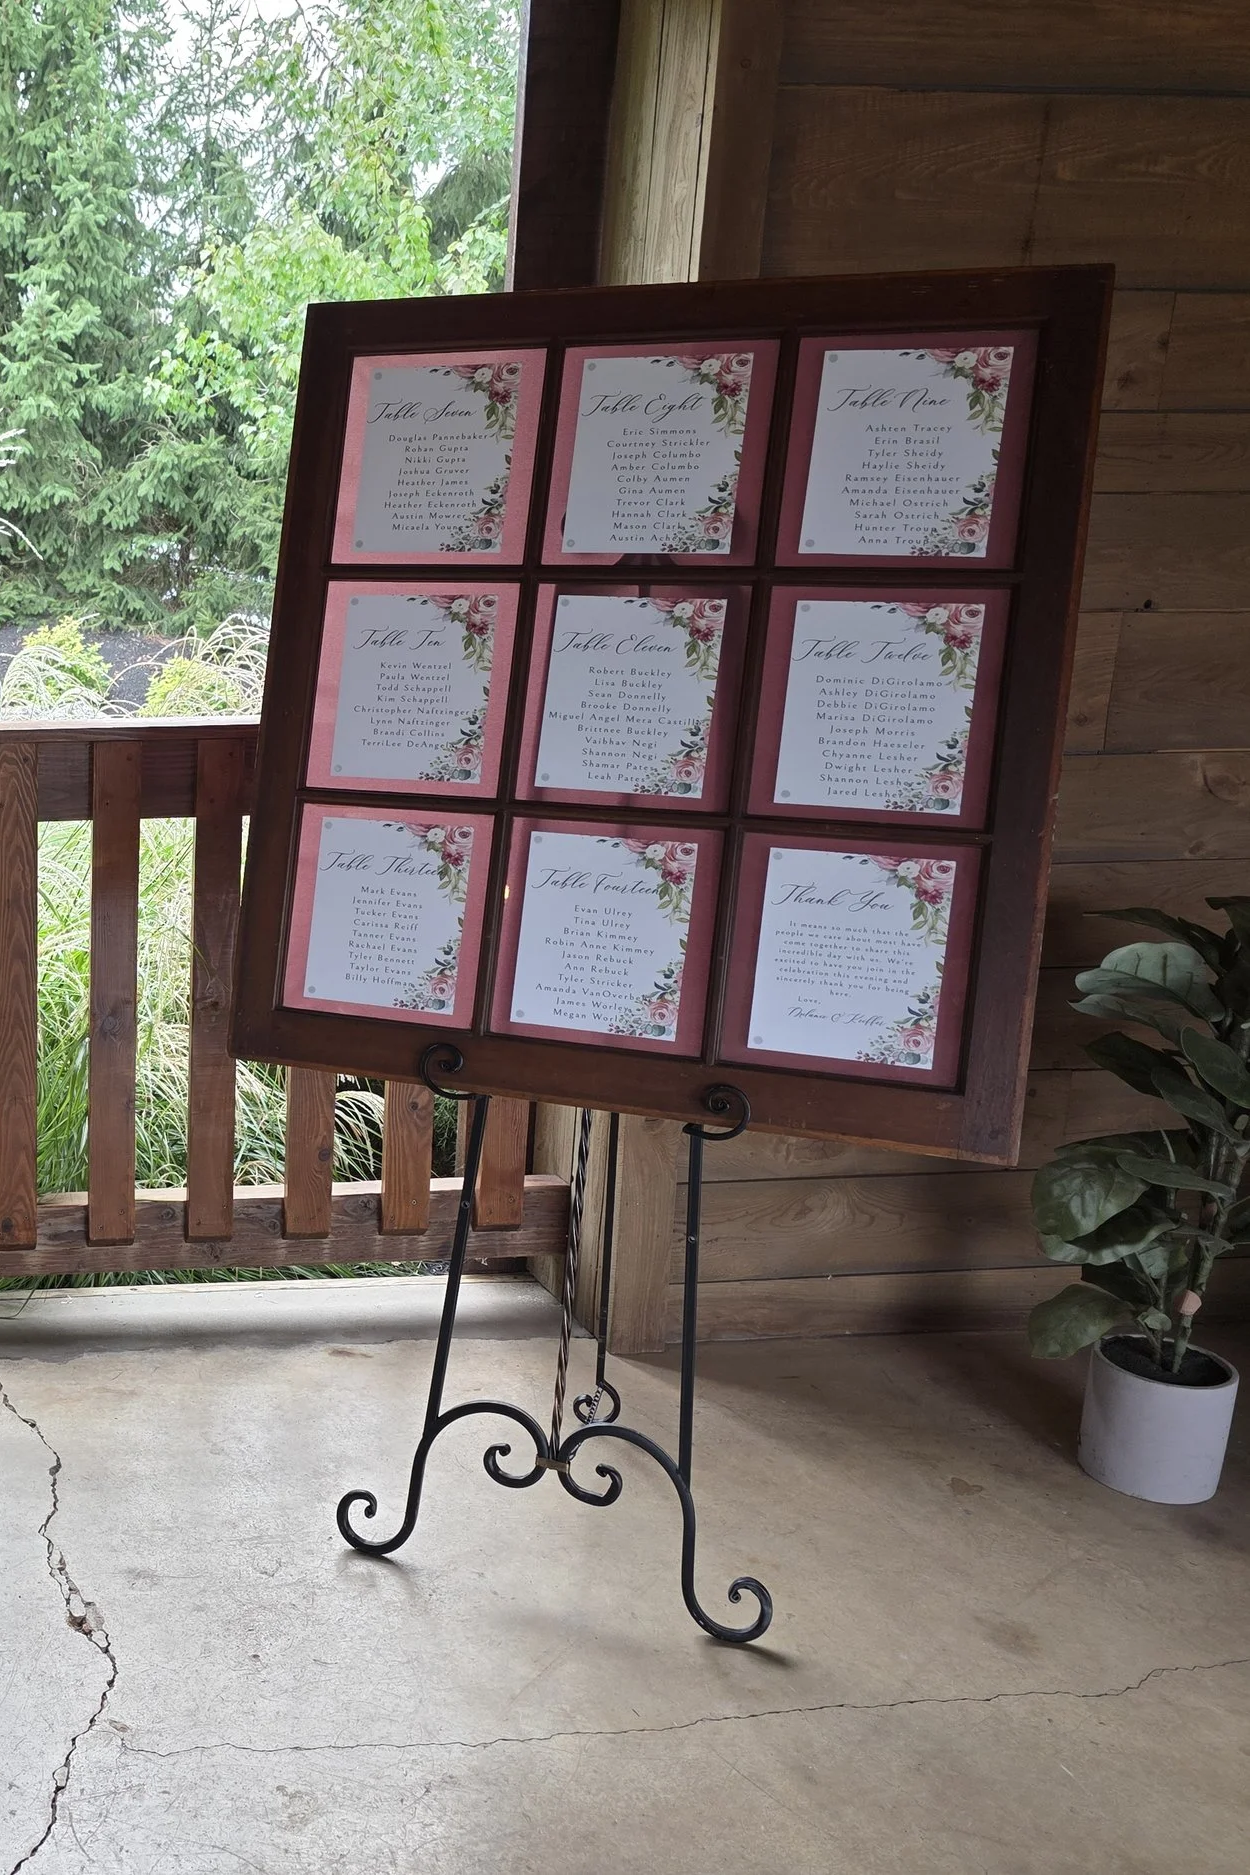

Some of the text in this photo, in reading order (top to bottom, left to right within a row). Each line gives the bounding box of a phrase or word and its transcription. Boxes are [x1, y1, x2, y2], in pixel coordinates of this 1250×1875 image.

[826, 384, 952, 414] Table Nine
[366, 398, 477, 424] Table Seven
[581, 390, 704, 424] Table Eight
[622, 427, 697, 436] Eric Simmons
[865, 424, 953, 433] Ashten Tracey
[874, 436, 940, 445] Erin Brasil
[404, 456, 466, 465] Nikki Gupta
[612, 451, 701, 461] Joseph Columbo
[398, 468, 430, 476] Joshua
[611, 462, 700, 471] Amber Columbo
[845, 474, 962, 483] Ramsey Eisenhauer
[388, 488, 475, 499] Joseph Eckenroth
[841, 486, 962, 495] Amanda Eisenhauer
[616, 498, 686, 506] Trevor Clark
[352, 625, 447, 651] Table Ten
[553, 628, 675, 655] Table Eleven
[792, 635, 934, 664] Table Twelve
[412, 662, 452, 670] Wentzel
[588, 667, 672, 679] Robert Buckley
[594, 679, 663, 690] Lisa Buckley
[815, 675, 943, 687] Dominic DiGirolamo
[376, 683, 451, 694] Todd Schappell
[819, 688, 936, 700] Ashley DiGirolamo
[373, 728, 445, 737] Brandi Collins
[830, 725, 916, 737] Joseph Morris
[585, 736, 658, 750] Vaibhav Negi
[825, 762, 913, 774] Dwight Lesher
[319, 849, 375, 872] Table
[531, 866, 660, 895] Table Fourteen
[352, 896, 423, 910] Jennifer Evans
[770, 883, 895, 913] Thank You
[354, 907, 419, 920] Tucker Evans
[574, 905, 633, 918] Evan Ulrey
[800, 922, 828, 930] means
[563, 927, 639, 943] Brian Kimmey
[348, 952, 416, 965] Tyler Bennett
[562, 950, 635, 965] Jason Rebuck
[349, 962, 412, 976] Taylor Evans
[558, 974, 634, 989] Tyler Stricker
[797, 995, 822, 1005] Love,
